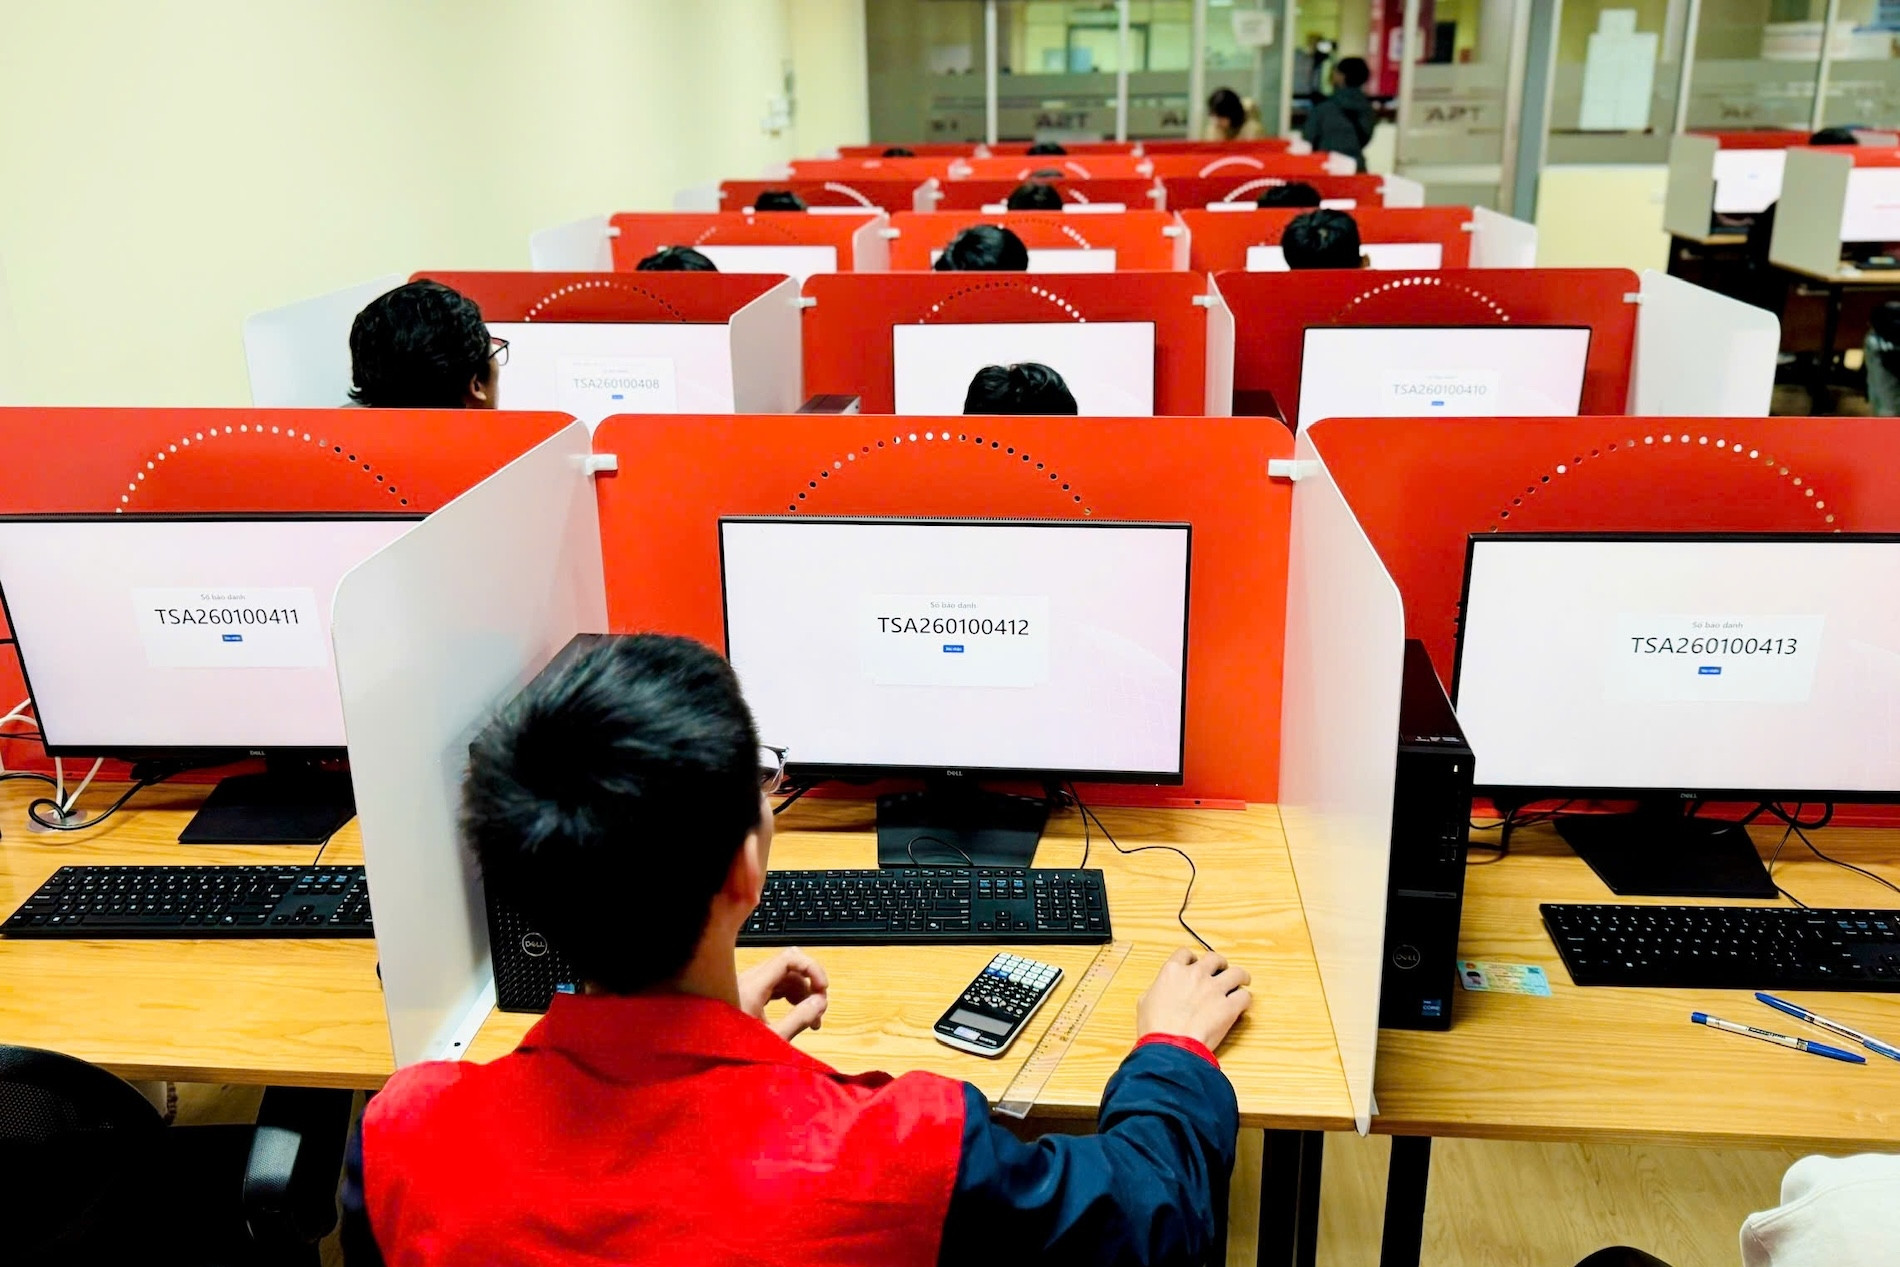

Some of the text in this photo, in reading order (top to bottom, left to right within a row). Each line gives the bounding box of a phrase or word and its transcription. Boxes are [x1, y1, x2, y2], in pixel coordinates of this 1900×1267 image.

[573, 378, 660, 389] TSA260100408
[1393, 384, 1488, 395] TSA260100410
[154, 608, 299, 625] TSA260100411
[877, 617, 1030, 636] TSA260100412
[1631, 637, 1798, 655] TSA260100413
